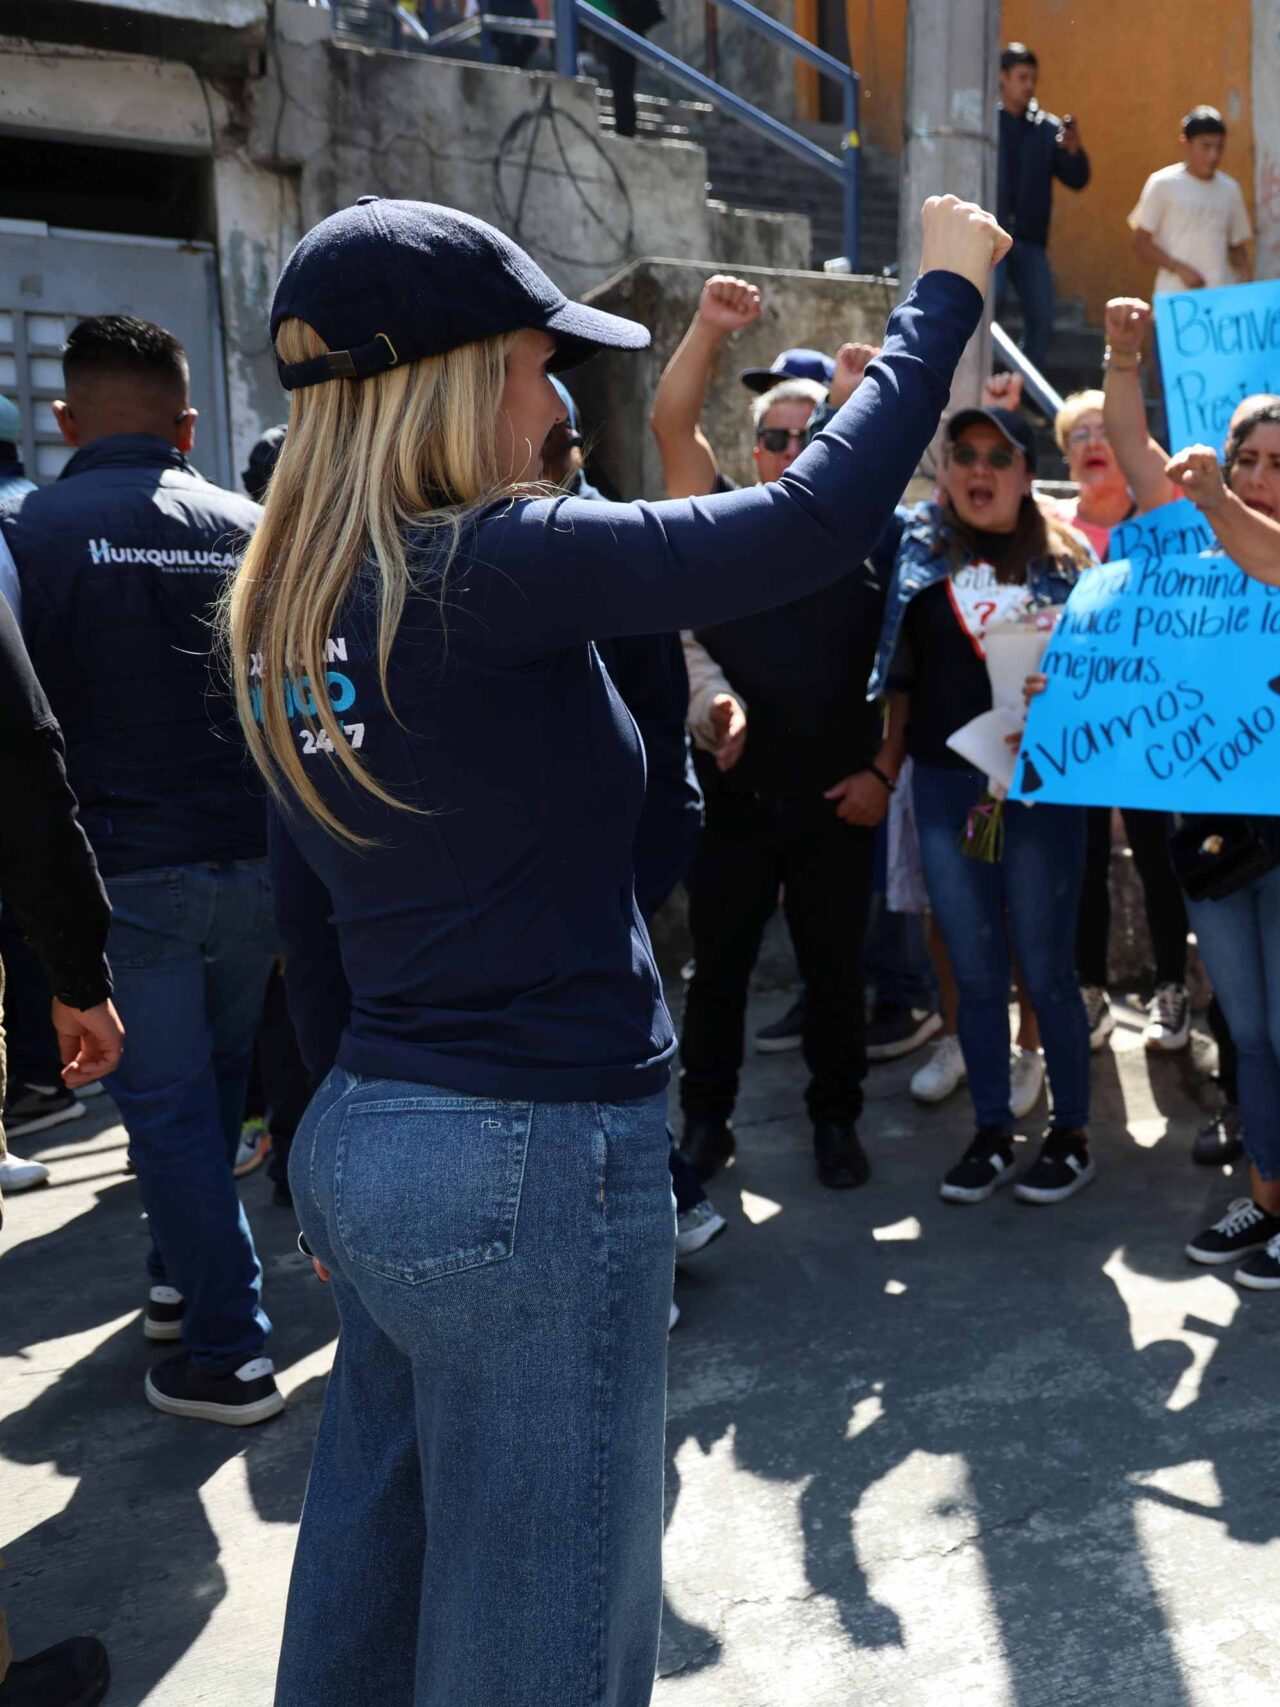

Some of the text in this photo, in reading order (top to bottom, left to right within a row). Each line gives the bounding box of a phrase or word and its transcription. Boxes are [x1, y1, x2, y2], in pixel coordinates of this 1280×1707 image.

[1138, 556, 1250, 599] Romina
[1057, 605, 1121, 637] hace
[1133, 605, 1249, 647] posible
[1145, 712, 1215, 780] con
